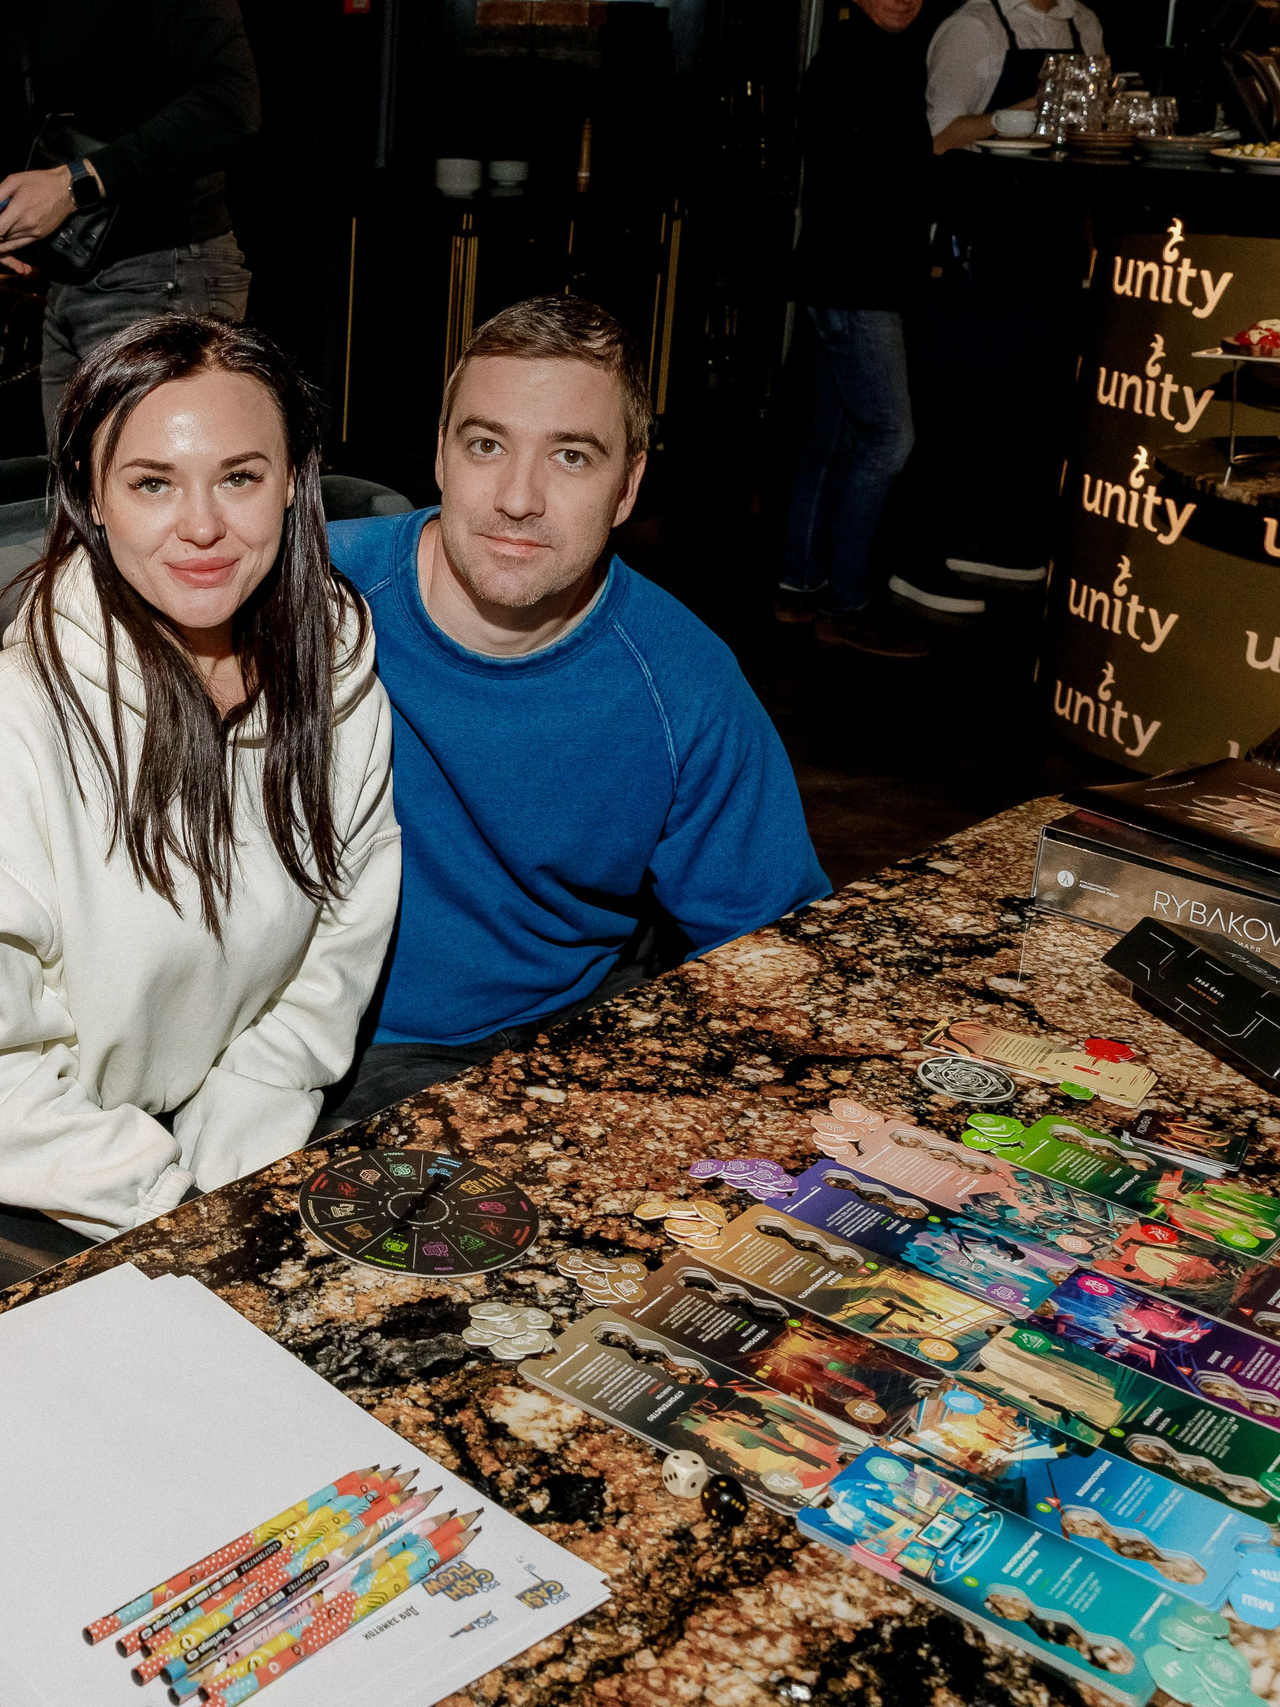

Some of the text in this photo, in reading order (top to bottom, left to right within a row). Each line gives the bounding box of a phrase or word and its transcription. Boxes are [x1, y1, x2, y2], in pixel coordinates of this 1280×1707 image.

[1113, 217, 1234, 319] unity
[1096, 333, 1215, 434] unity
[1081, 445, 1197, 545] unity
[1068, 554, 1179, 653] unity
[1053, 661, 1162, 757] unity
[421, 1560, 475, 1597] FLOW
[441, 1568, 495, 1602] CASH
[150, 1604, 186, 1632] Berlingo
[196, 1625, 232, 1656] Berlingo
[362, 1603, 419, 1639] Для заметок
